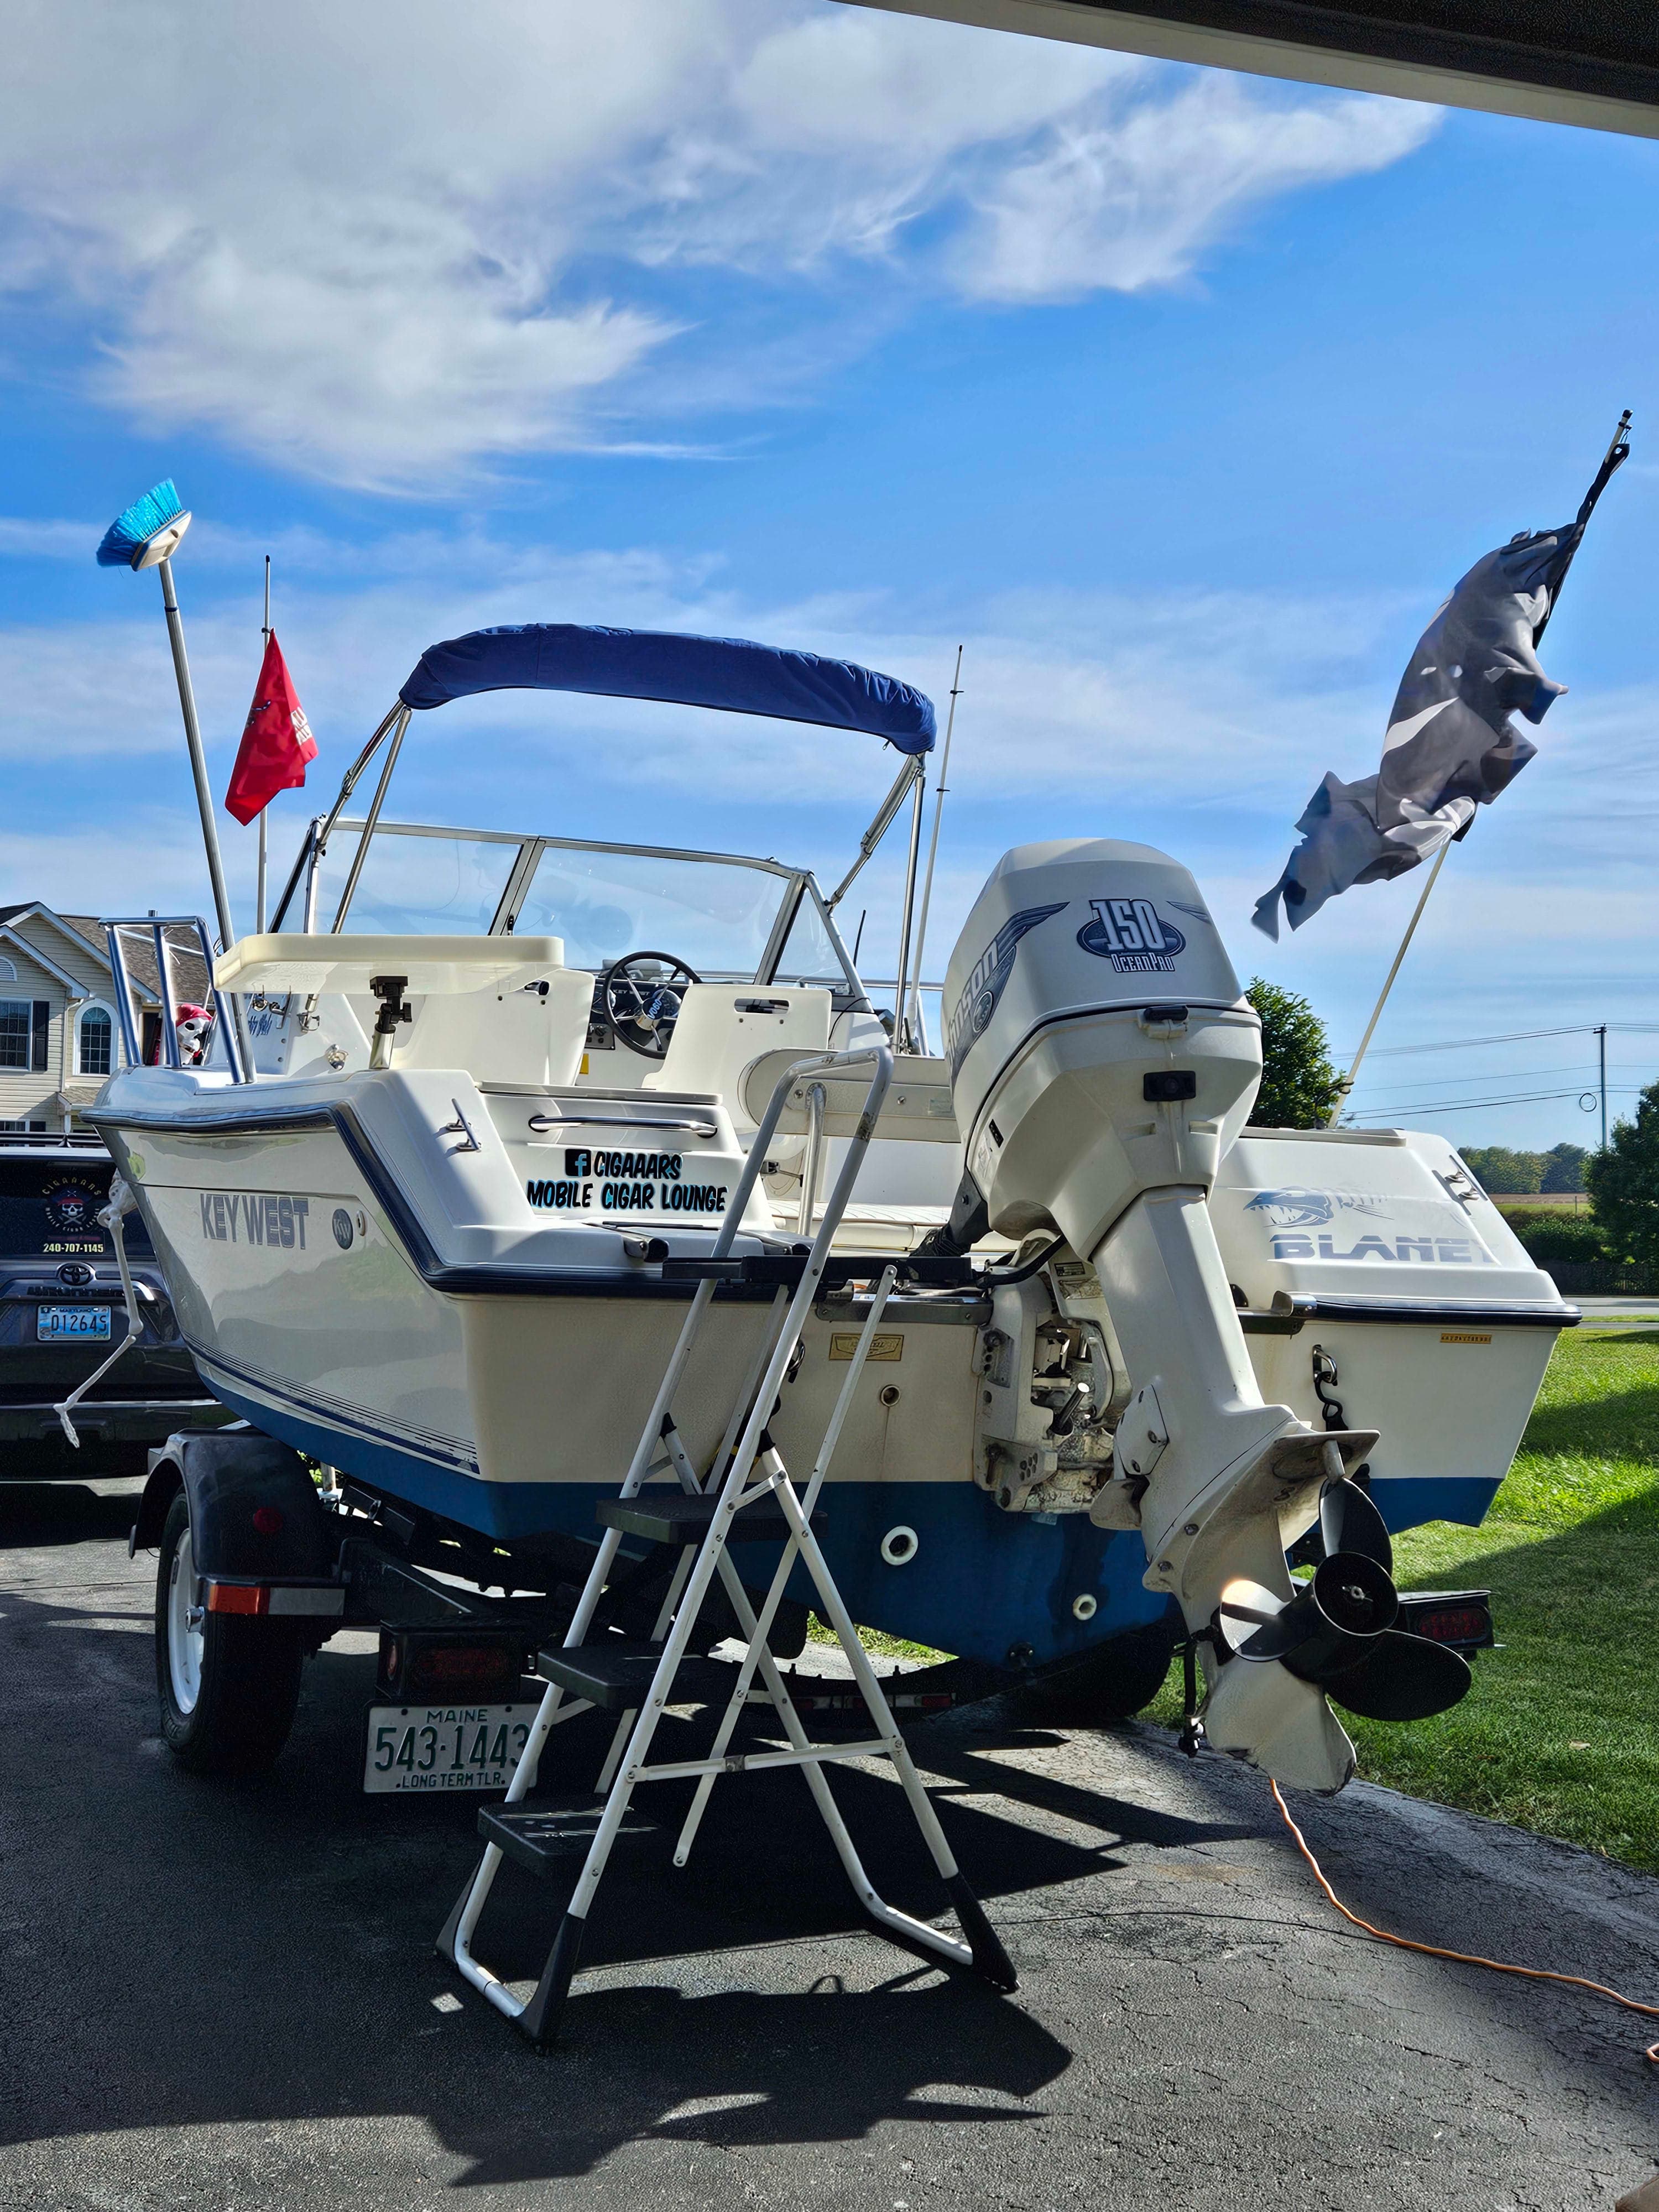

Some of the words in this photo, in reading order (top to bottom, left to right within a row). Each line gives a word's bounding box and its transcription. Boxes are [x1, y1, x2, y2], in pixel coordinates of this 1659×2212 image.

[1089, 899, 1167, 952] 150
[593, 1151, 684, 1180] CIGAAARS
[527, 1180, 594, 1209] MOBILE
[601, 1182, 655, 1210] CIGAR
[661, 1182, 727, 1212] LOUNGE
[200, 1193, 241, 1243] KEY
[241, 1194, 310, 1250] WEST
[43, 1243, 104, 1253] 240-707-1145
[426, 1709, 488, 1723] MAINE
[402, 1773, 437, 1788] LONG
[440, 1771, 474, 1788] TERM
